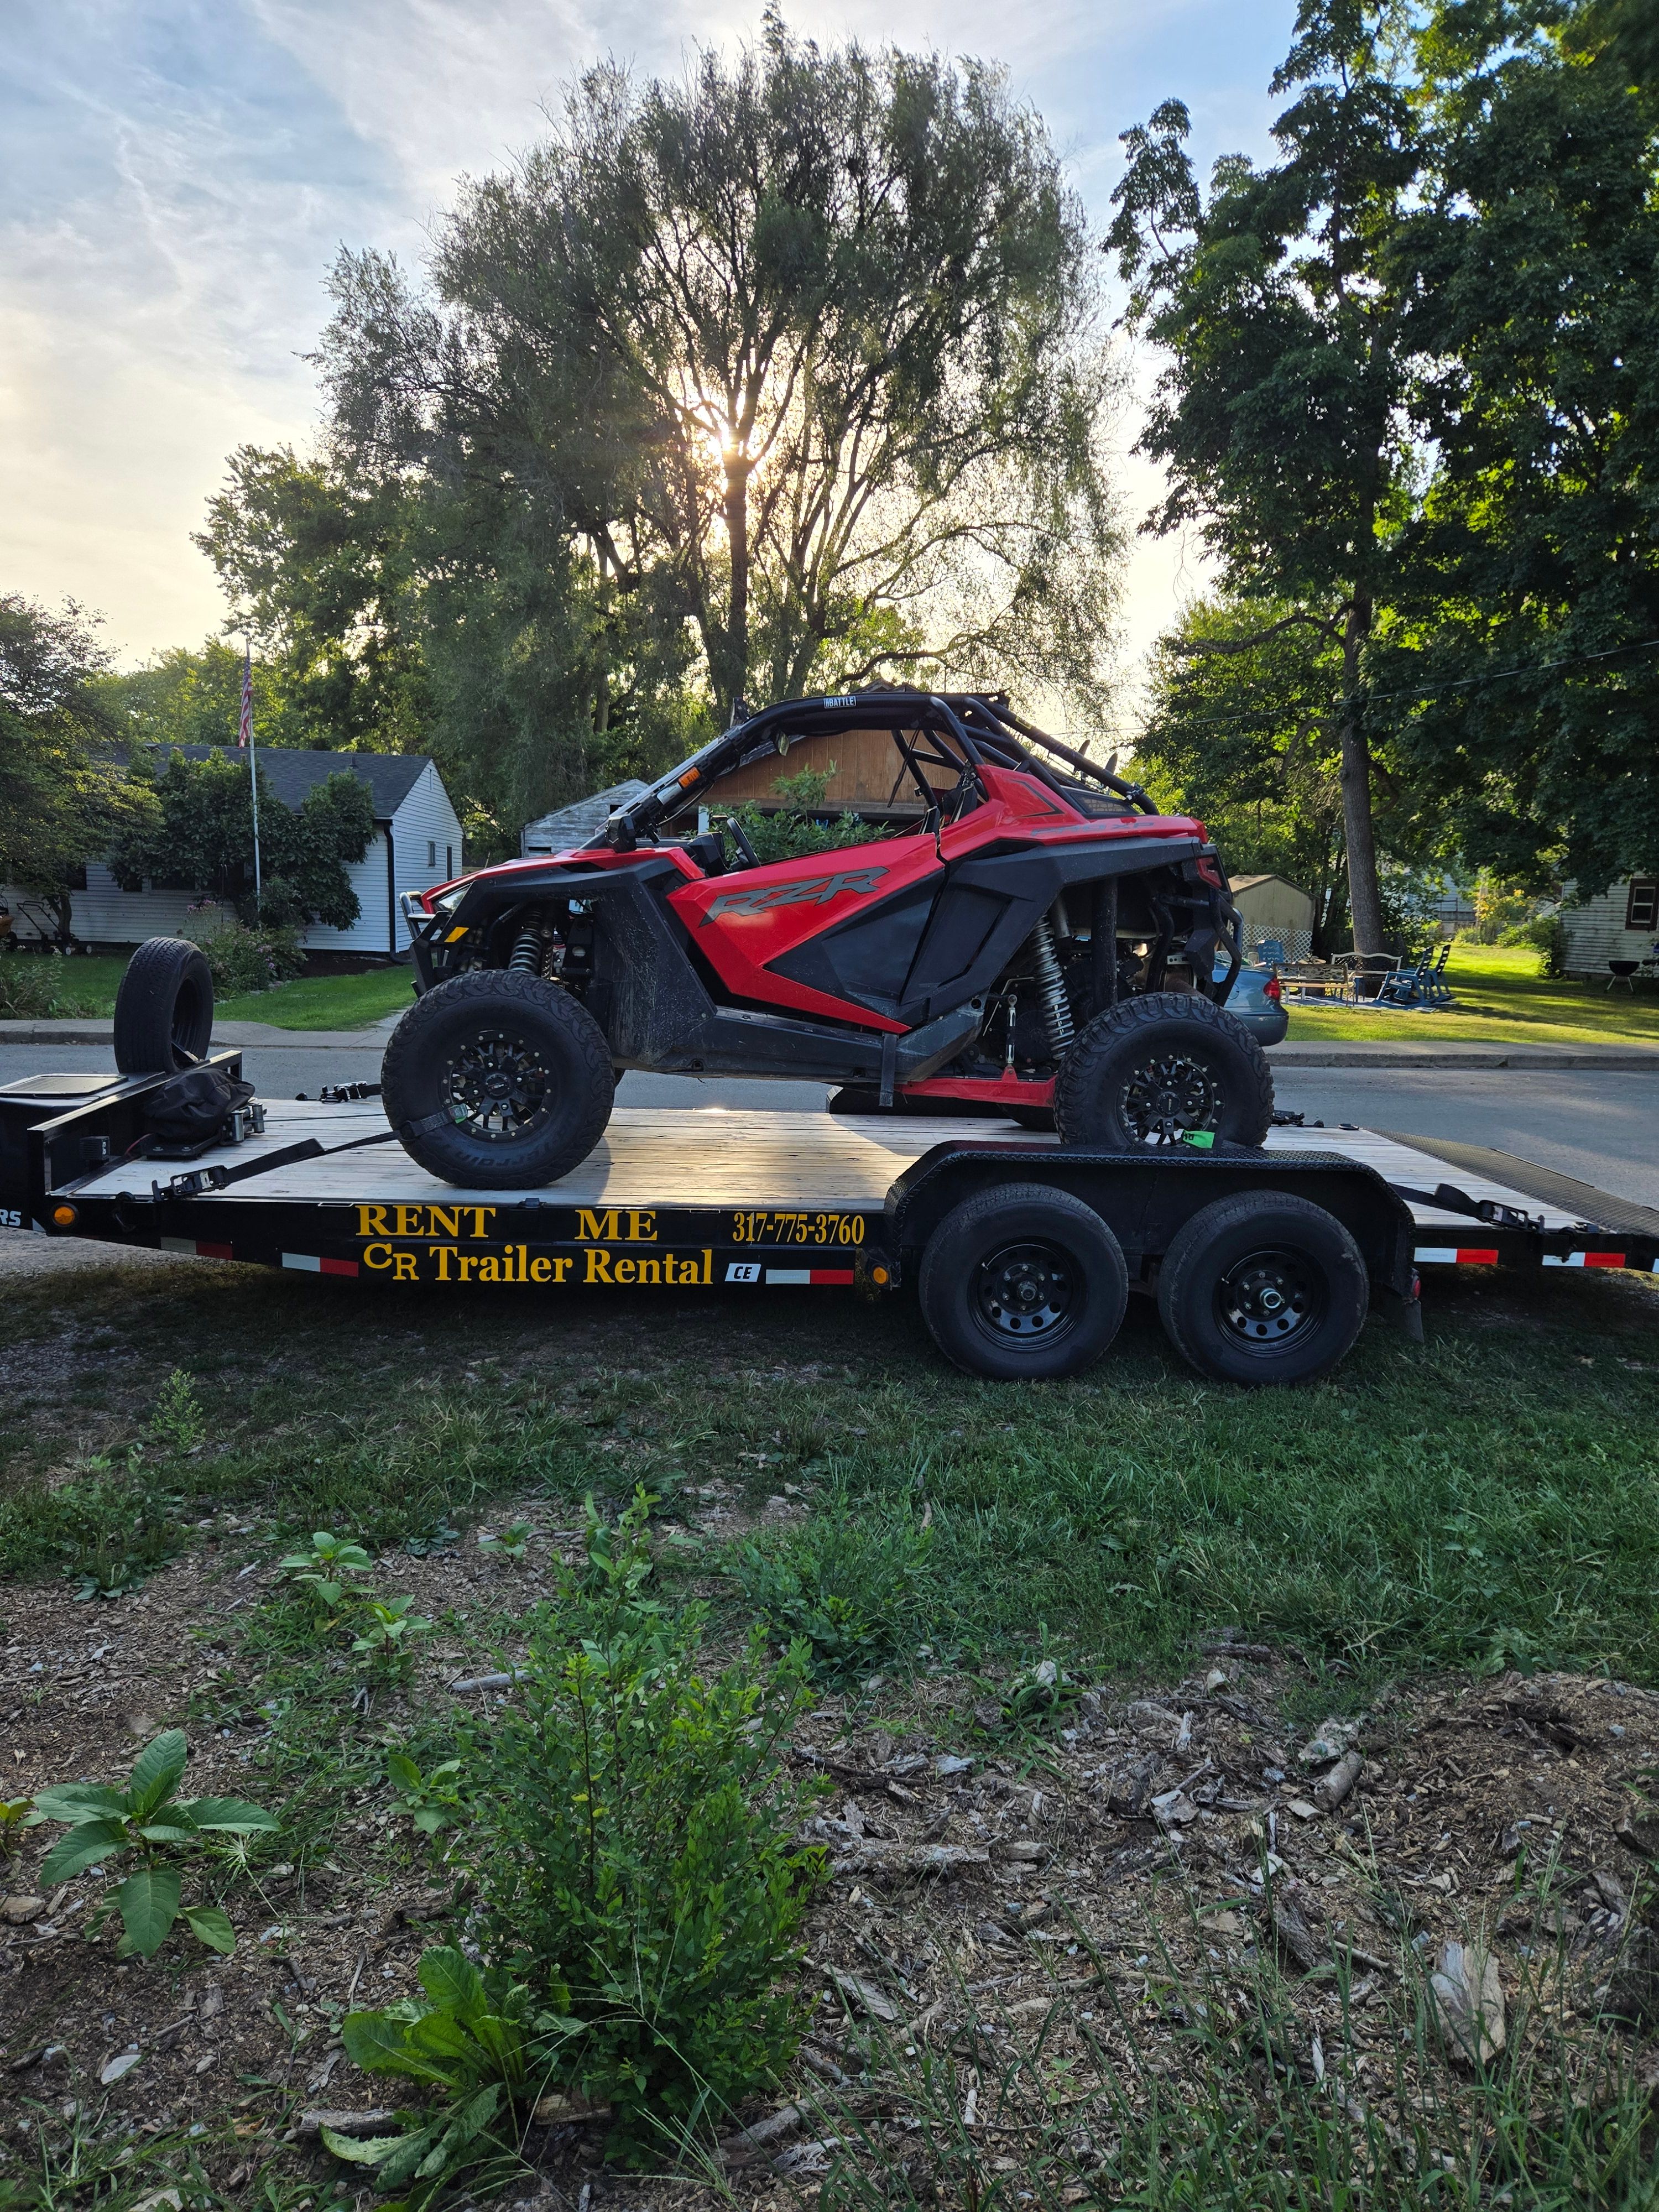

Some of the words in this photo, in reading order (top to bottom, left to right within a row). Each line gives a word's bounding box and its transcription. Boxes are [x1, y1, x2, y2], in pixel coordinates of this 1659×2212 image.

[830, 697, 854, 707] BATTLE
[698, 866, 891, 928] RZR
[355, 1205, 496, 1238] RENT
[575, 1209, 658, 1240] ME
[733, 1212, 865, 1244] 317-775-3760
[429, 1245, 573, 1283] Trailer
[584, 1249, 713, 1284] Rental
[734, 1266, 753, 1279] CE
